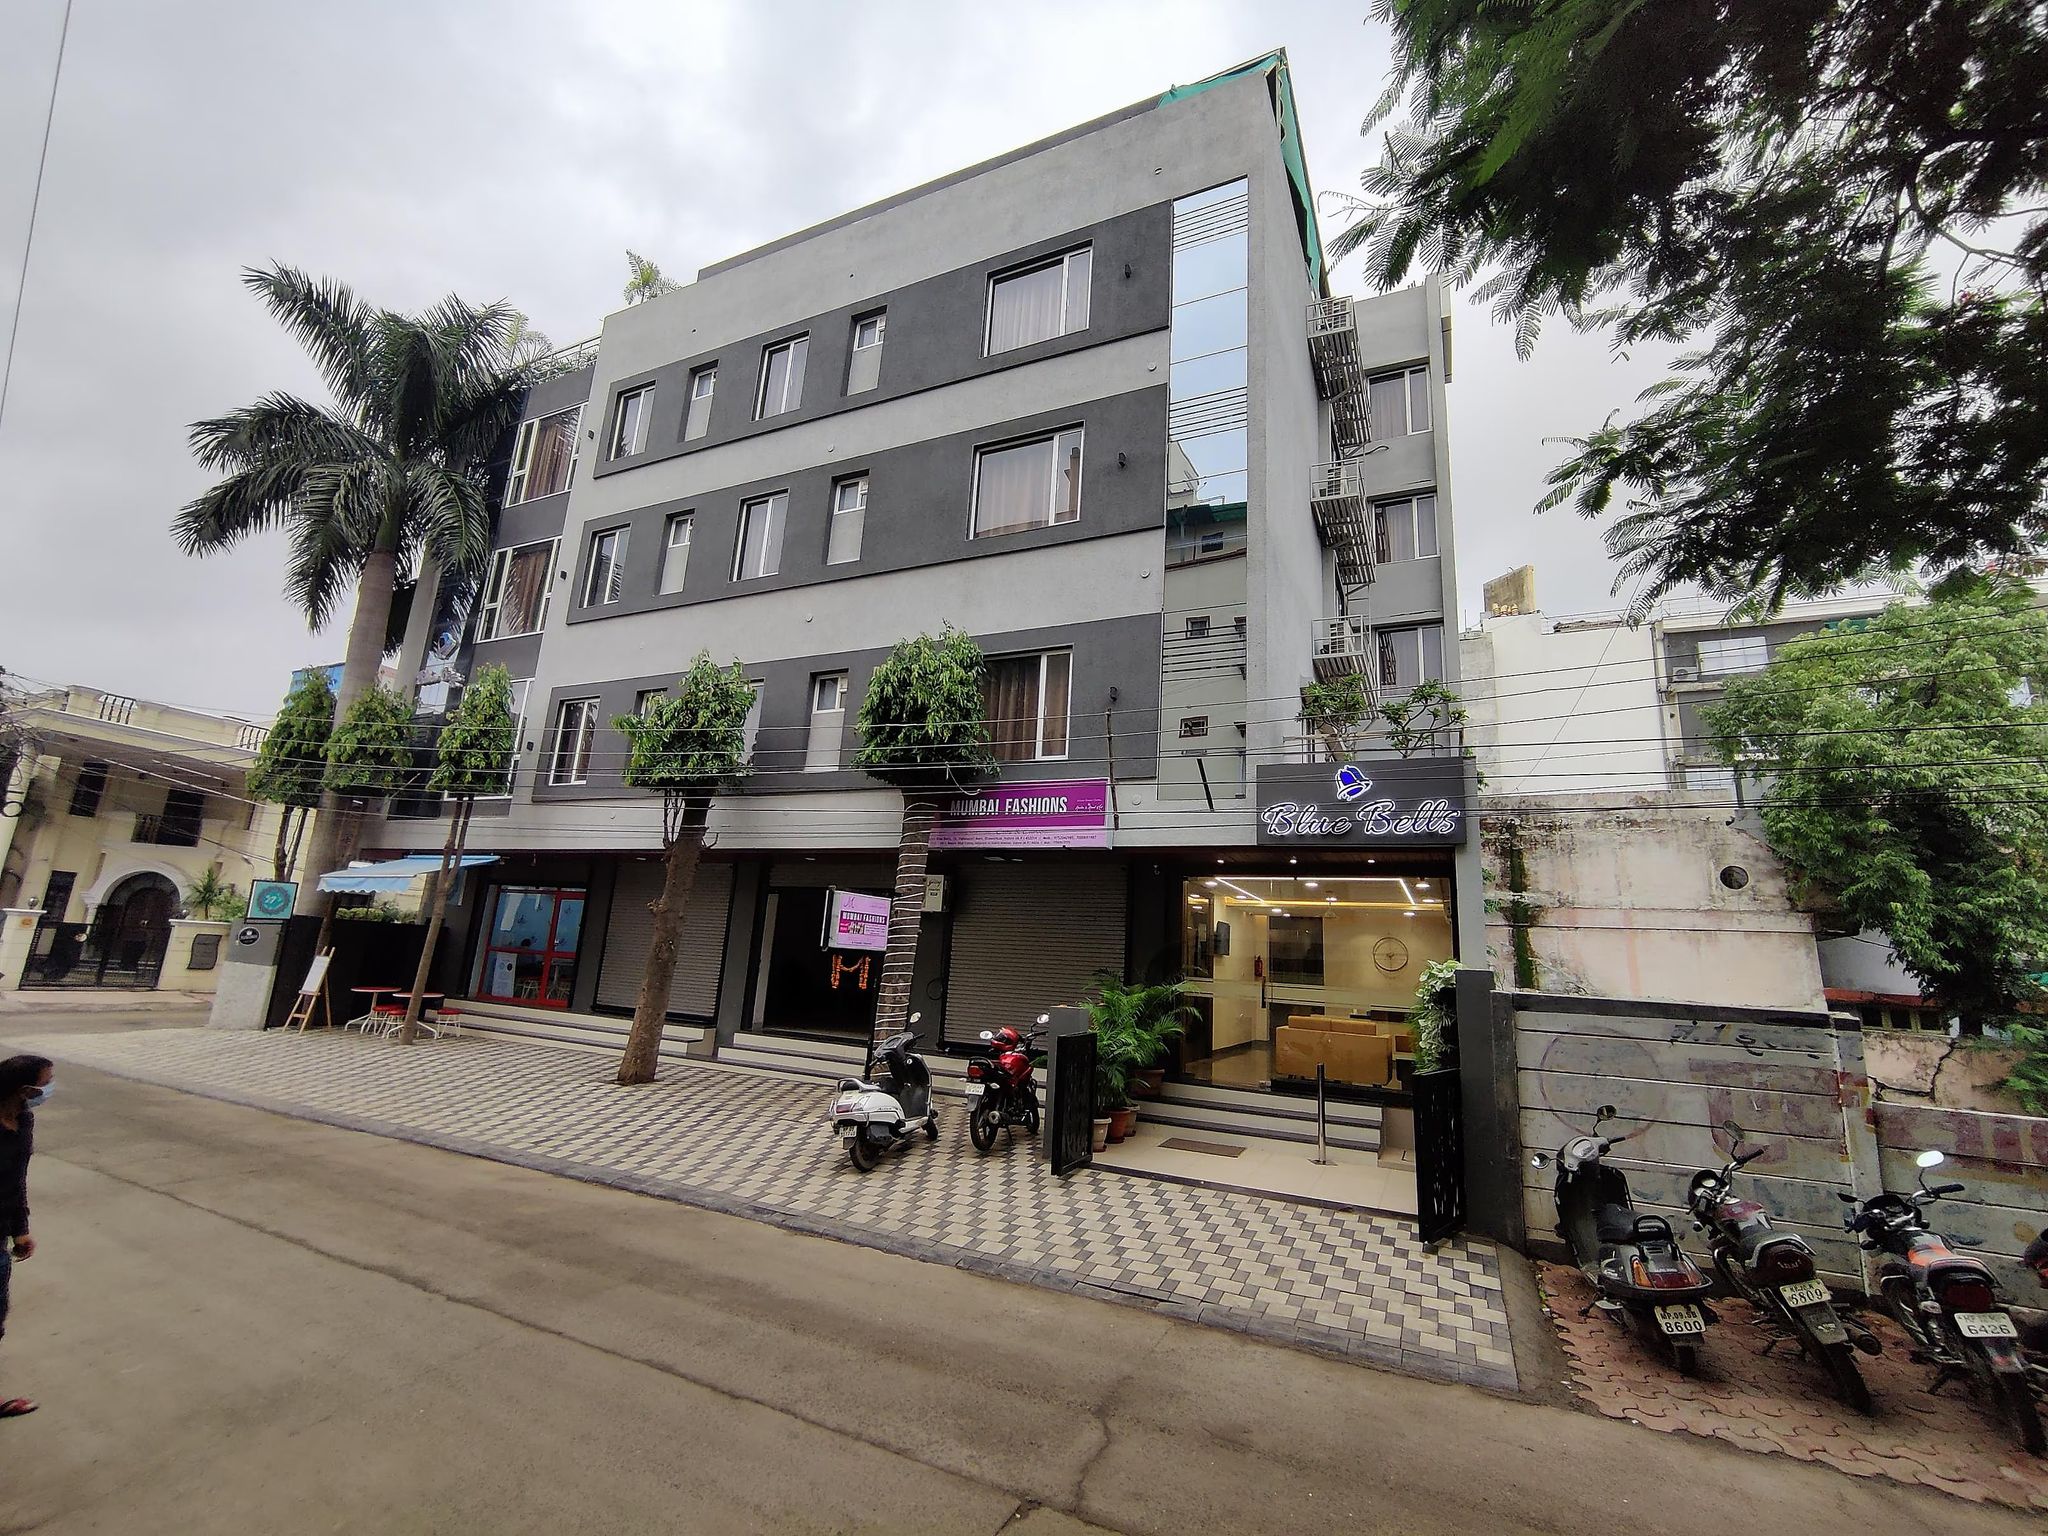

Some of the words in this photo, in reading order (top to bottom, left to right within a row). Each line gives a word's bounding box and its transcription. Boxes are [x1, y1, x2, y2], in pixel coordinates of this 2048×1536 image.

[950, 798, 999, 816] MUMBAI
[1005, 797, 1067, 816] FASHIONS
[1261, 802, 1352, 836] Blue
[1356, 799, 1460, 835] Bells
[1664, 1320, 1703, 1333] 8600
[1967, 1324, 2011, 1335] 6426
